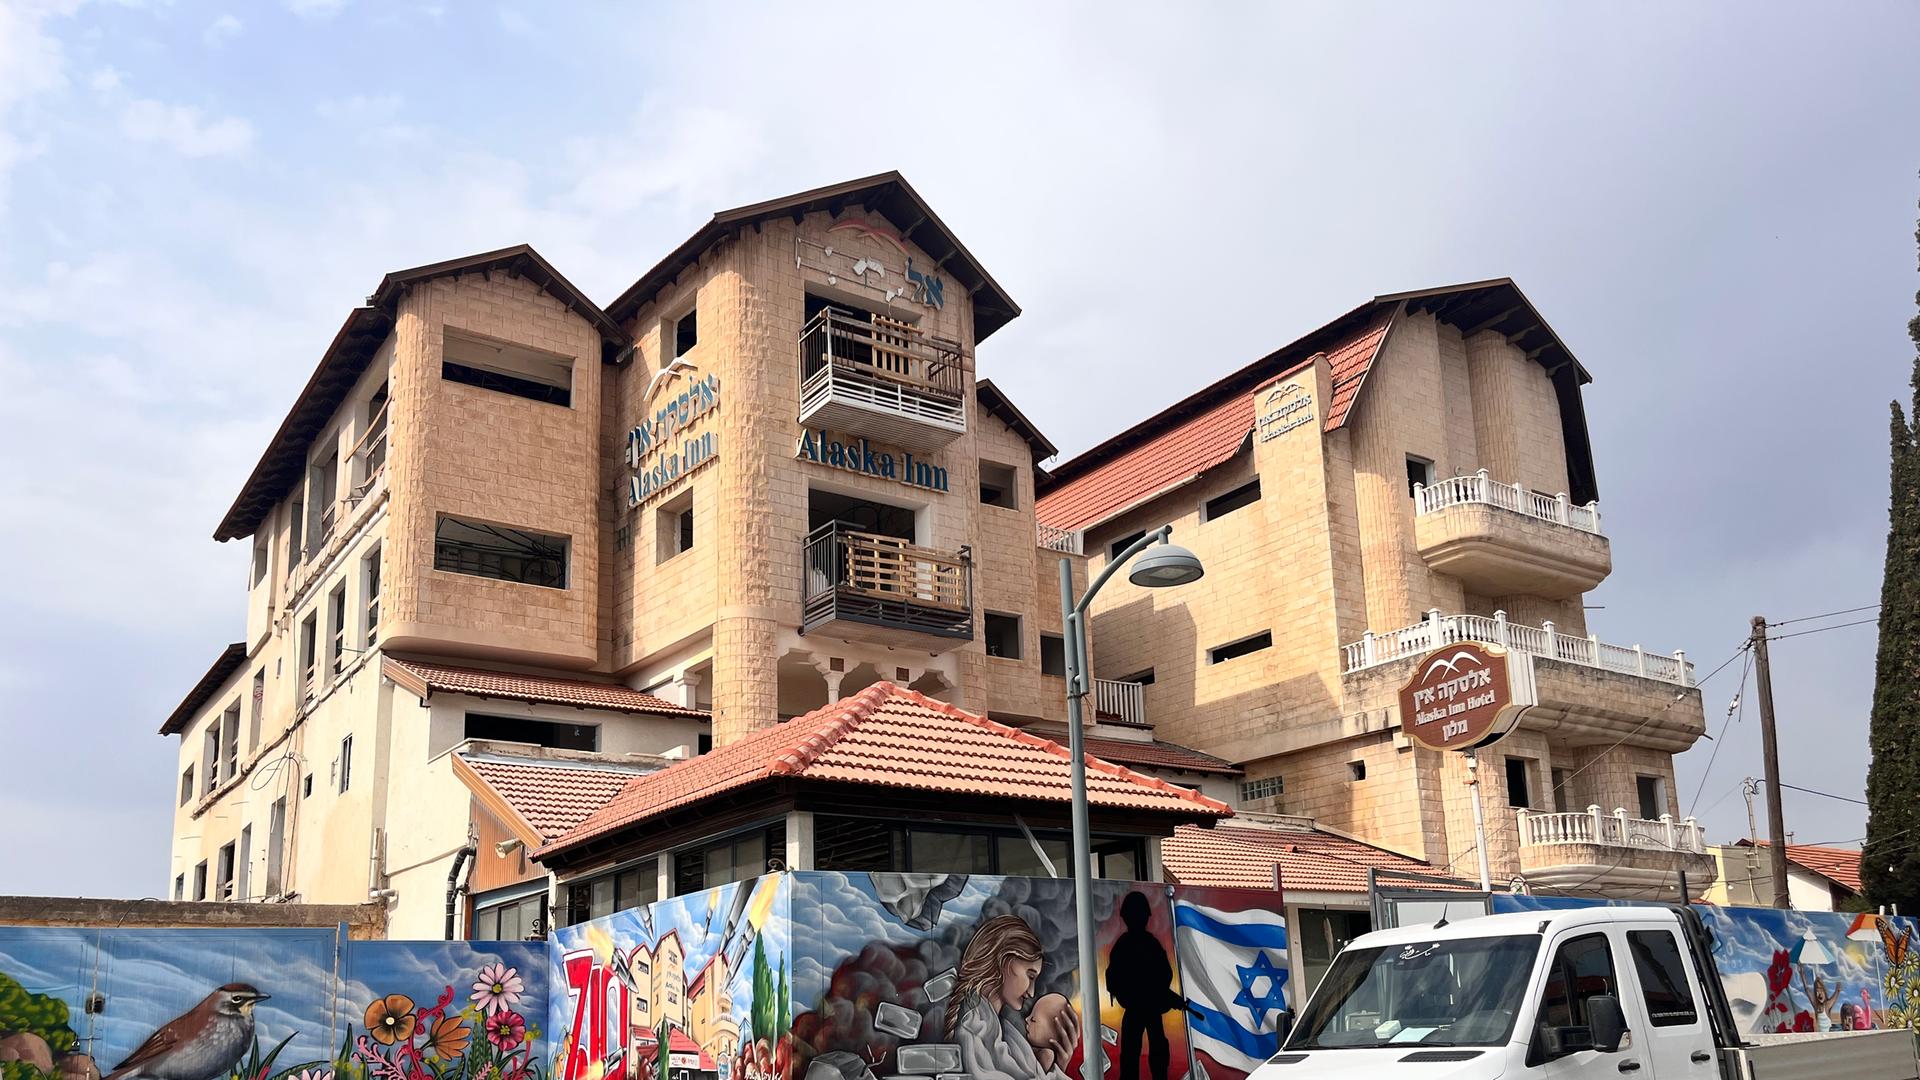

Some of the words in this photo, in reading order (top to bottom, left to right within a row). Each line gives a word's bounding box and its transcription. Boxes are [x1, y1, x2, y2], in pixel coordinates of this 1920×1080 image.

[656, 373, 719, 442] אלסקה
[628, 452, 679, 507] Alaska
[684, 432, 718, 473] Inn
[794, 428, 896, 480] Alaska
[901, 453, 949, 494] Inn
[1413, 686, 1436, 713] אין
[1437, 668, 1492, 702] אלסקה
[1415, 707, 1448, 727] Alaska
[1448, 702, 1466, 716] Inn
[1467, 689, 1496, 711] Hotel
[1442, 719, 1468, 742] מלון
